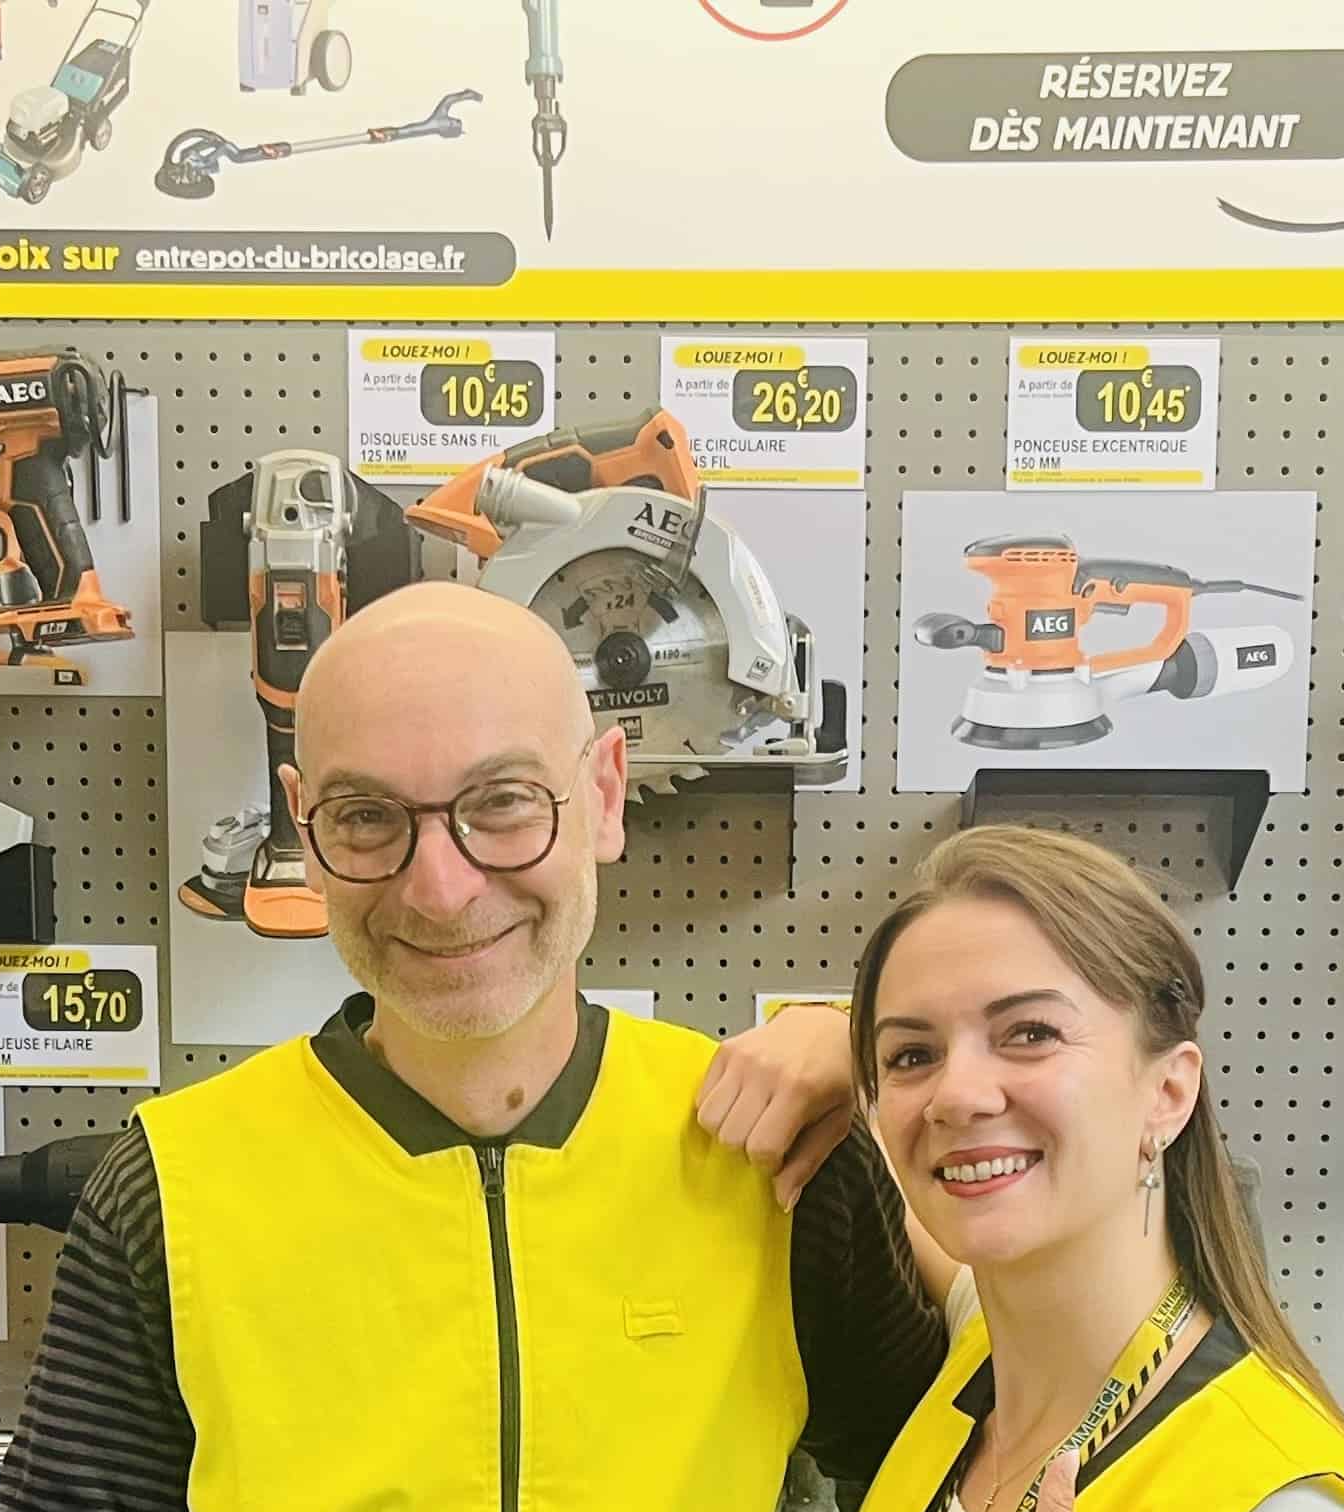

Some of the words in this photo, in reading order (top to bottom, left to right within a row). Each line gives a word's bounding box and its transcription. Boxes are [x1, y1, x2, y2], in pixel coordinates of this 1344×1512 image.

[1039, 56, 1233, 98] RÉSERVEZ
[968, 114, 1042, 152] DÈS
[1053, 113, 1301, 151] MAINTENANT
[63, 247, 120, 271] sur
[136, 244, 464, 272] entrepot-du-bricolage.fr
[382, 346, 460, 358] LOUEZ-MOI
[695, 352, 773, 363] LOUEZ-MOI
[1039, 352, 1117, 364] LOUEZ-MOI
[374, 373, 401, 386] partir
[405, 373, 416, 384] de
[686, 379, 713, 391] partir
[717, 378, 729, 389] de
[1029, 380, 1056, 391] partir
[1060, 379, 1072, 390] de
[361, 433, 436, 446] DISQUEUSE
[441, 434, 477, 447] SANS
[481, 434, 500, 447] FIL
[706, 439, 786, 452] CIRCULAIRE
[1014, 440, 1088, 452] PONCEUSE
[1092, 440, 1187, 453] EXCENTRIQUE
[361, 450, 381, 461] 125
[386, 450, 407, 461] MM
[711, 456, 730, 468] FIL
[1014, 457, 1035, 469] 150
[1039, 457, 1061, 469] MM
[1032, 616, 1069, 633] AEG
[1245, 650, 1268, 662] AEG
[607, 687, 665, 708] TIVOLY
[7, 981, 18, 991] de
[45, 1039, 92, 1050] FILAIRE
